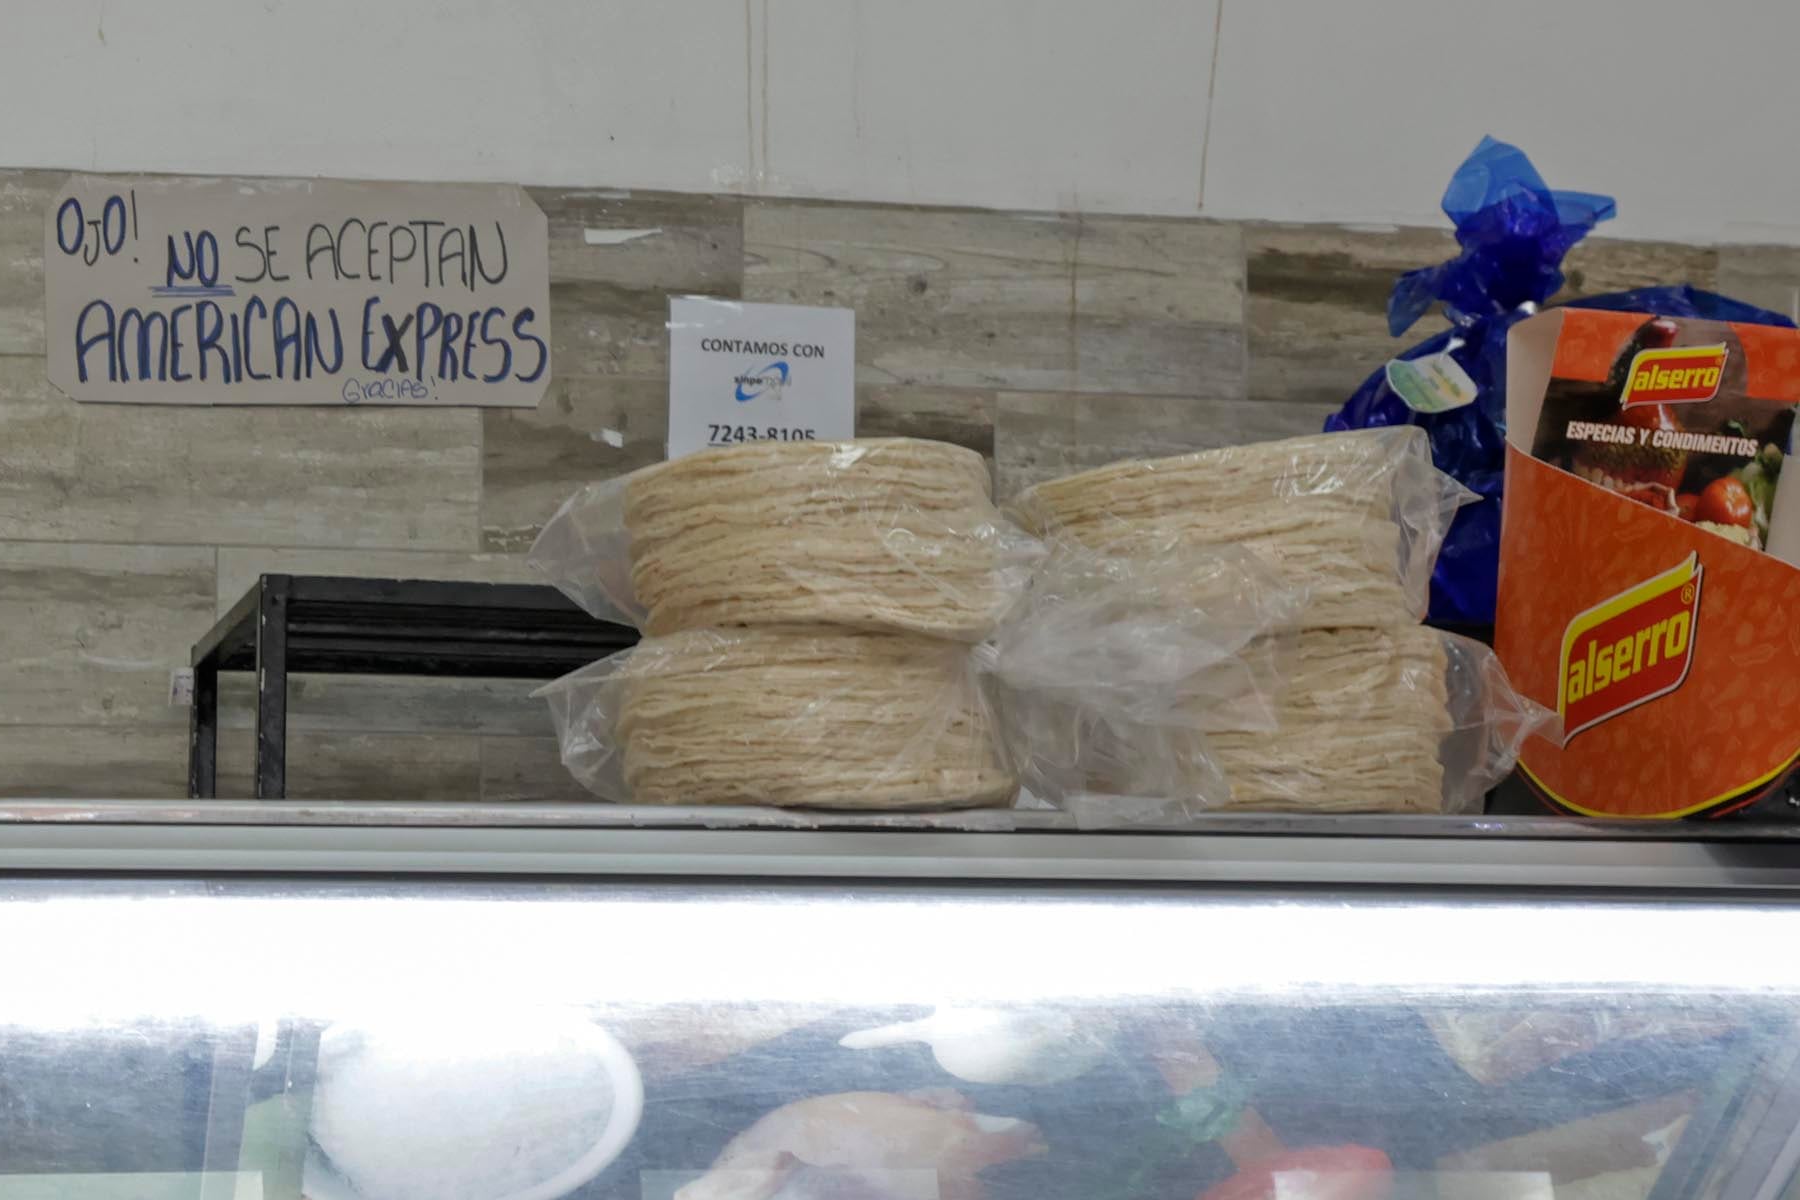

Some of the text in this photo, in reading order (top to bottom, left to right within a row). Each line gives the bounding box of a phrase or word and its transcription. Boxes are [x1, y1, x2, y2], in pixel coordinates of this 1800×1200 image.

[57, 190, 139, 265] OJO!
[168, 218, 508, 290] NO SE ACEPTAN
[76, 295, 547, 383] AMERICAN EXPRESS
[701, 338, 824, 358] CONTAMOS CON
[1566, 421, 1758, 457] ESPECIAS Y CONDIMENTOS
